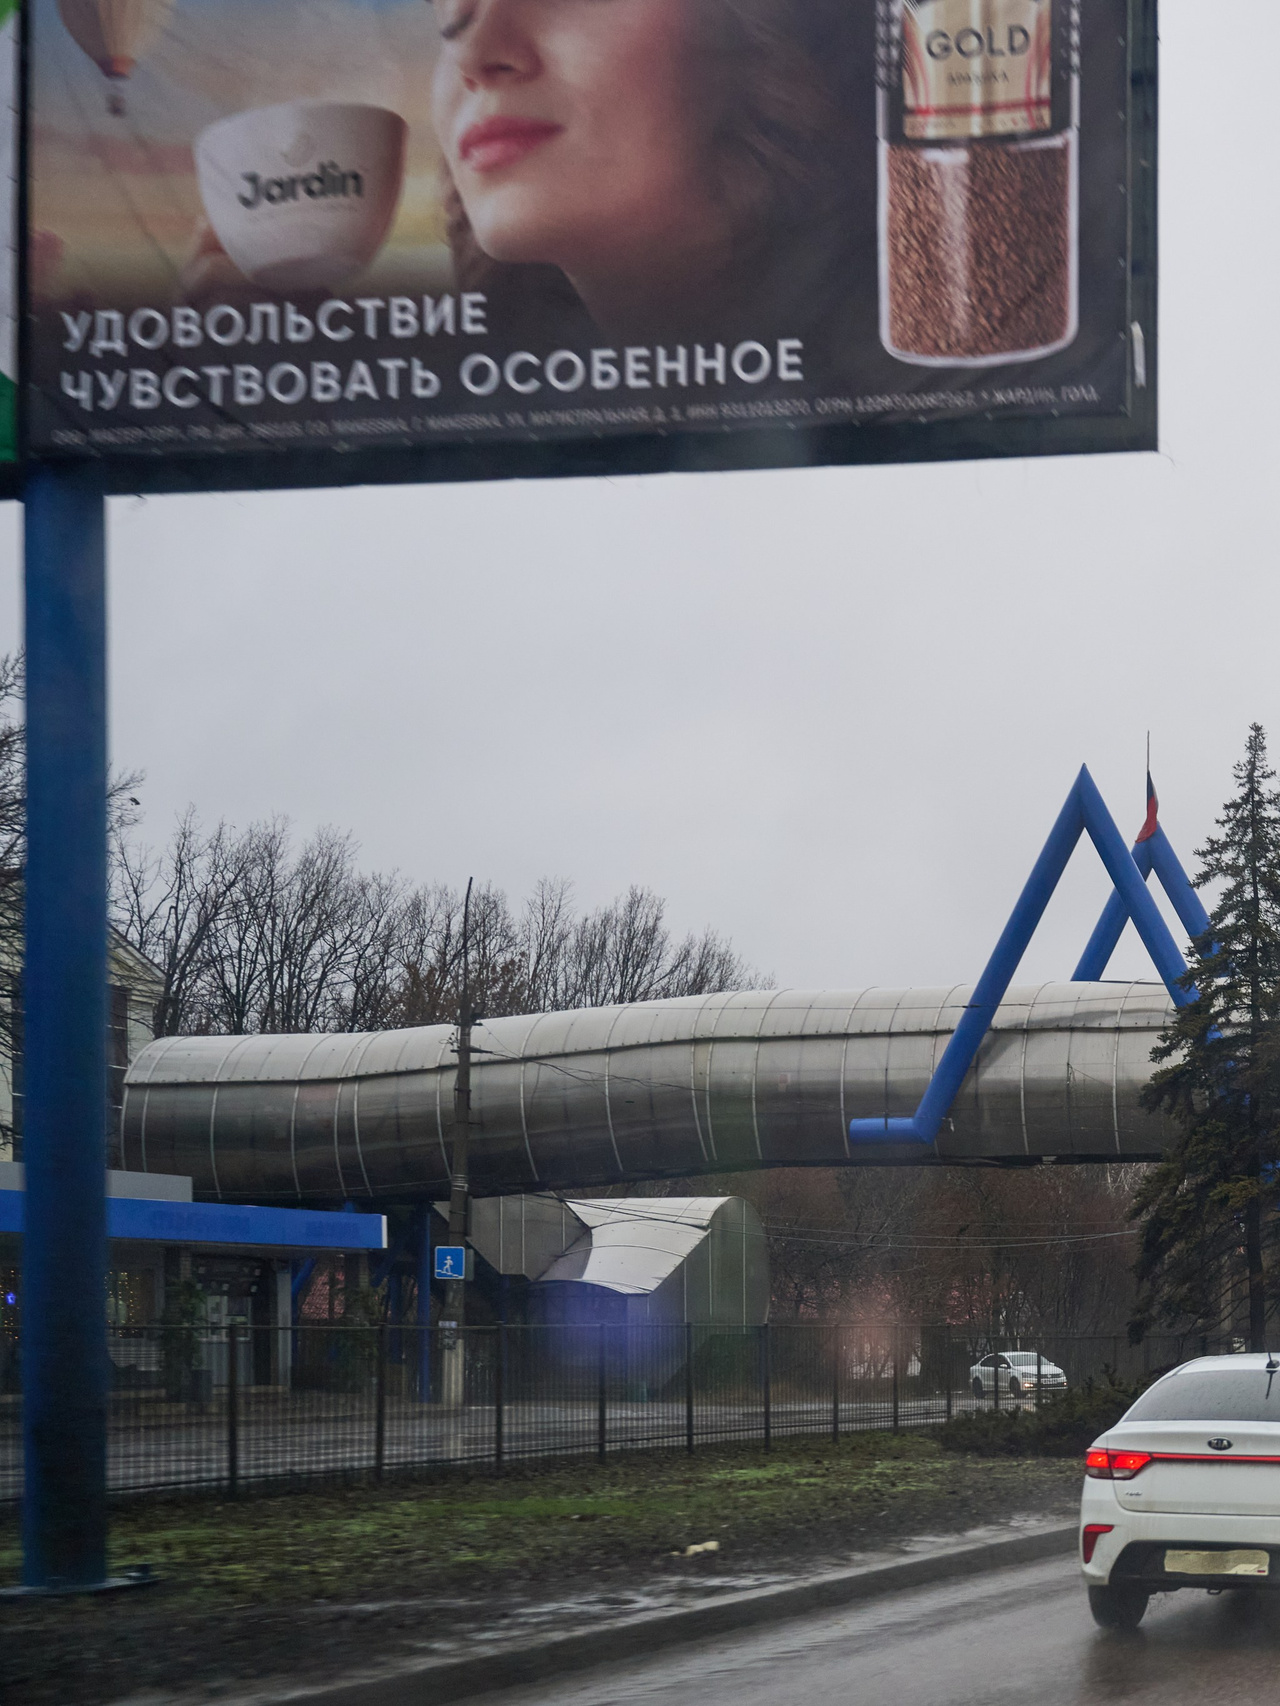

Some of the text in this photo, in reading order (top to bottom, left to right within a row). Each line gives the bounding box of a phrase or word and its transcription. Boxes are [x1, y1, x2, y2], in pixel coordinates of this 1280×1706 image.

[926, 22, 1033, 62] GOLD
[236, 159, 367, 210] Jardin
[60, 291, 490, 357] УДОВОЛЬСТВИЕ
[59, 338, 805, 413] ЧУВСТВОВАТЬ ОСОБЕННОЕ
[1209, 1438, 1231, 1449] KIA
